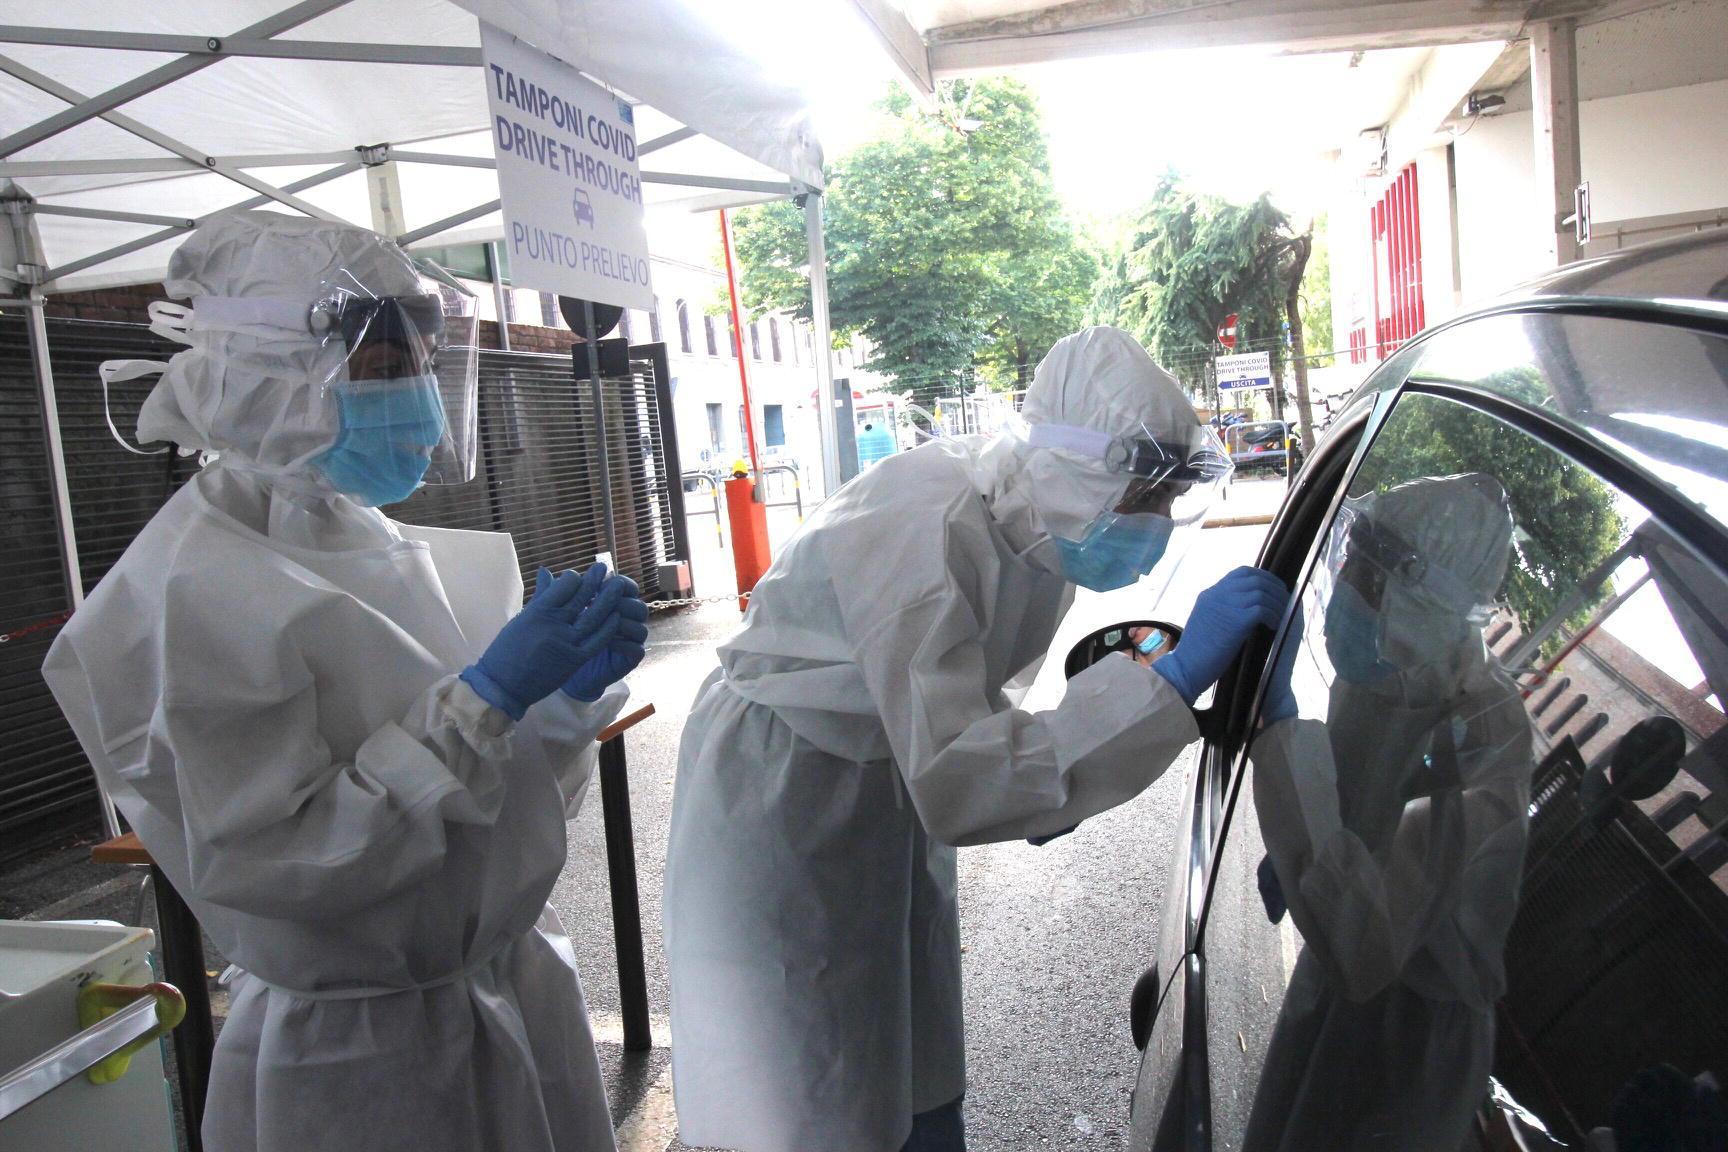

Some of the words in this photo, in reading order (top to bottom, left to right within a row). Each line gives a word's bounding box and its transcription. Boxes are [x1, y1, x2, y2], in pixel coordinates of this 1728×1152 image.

[490, 63, 584, 139] TAMPONI
[587, 114, 635, 162] COVID
[496, 114, 560, 171] DRIVE
[560, 144, 642, 204] THROUGH
[512, 221, 577, 268] PUNTO
[581, 241, 648, 287] PRELIEVO
[1217, 360, 1246, 368] TAMPONI
